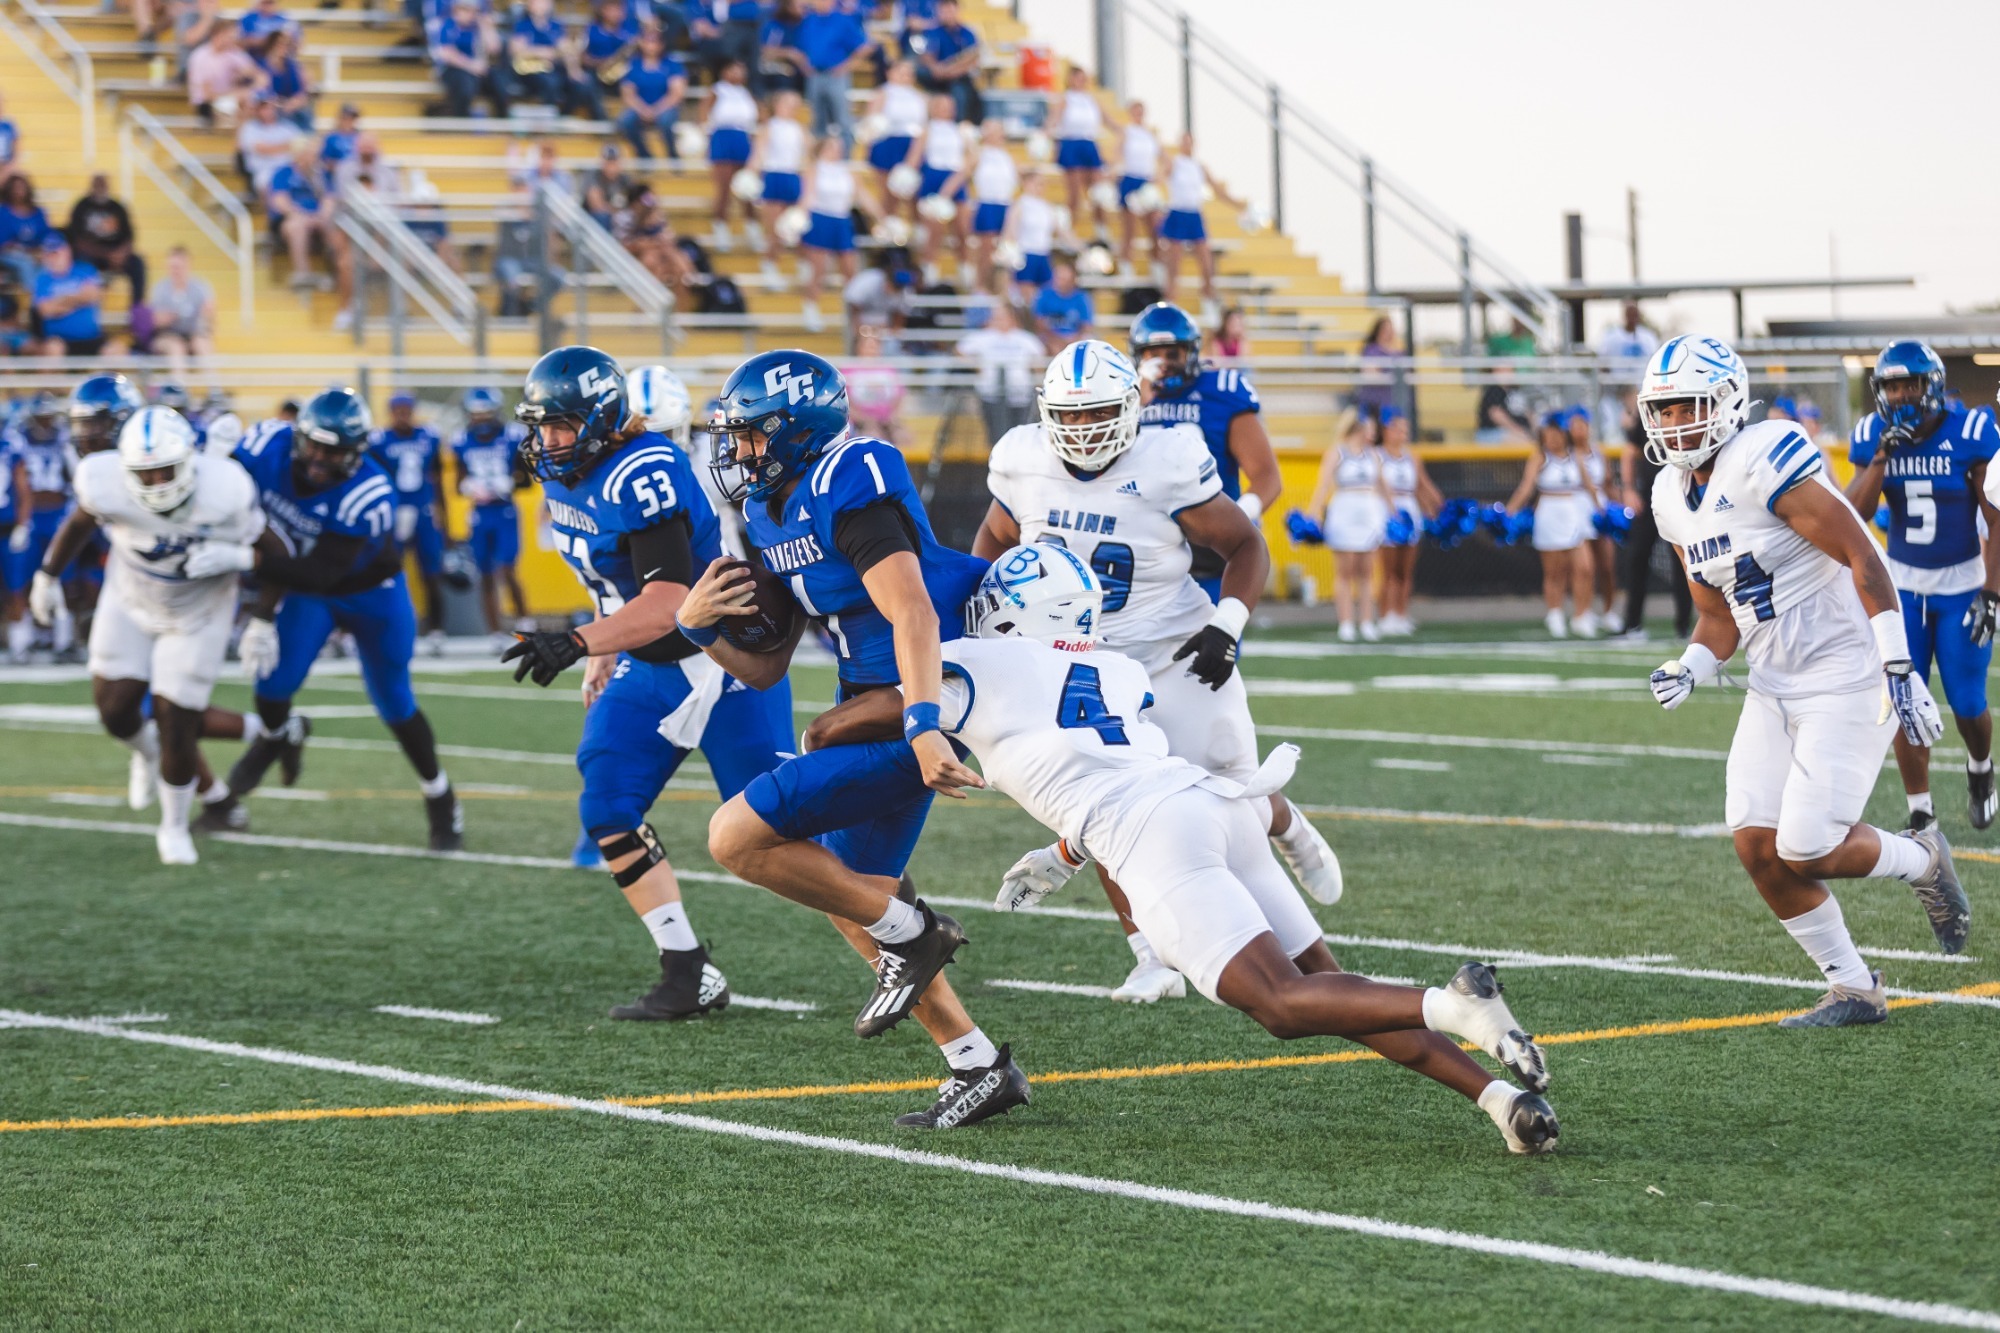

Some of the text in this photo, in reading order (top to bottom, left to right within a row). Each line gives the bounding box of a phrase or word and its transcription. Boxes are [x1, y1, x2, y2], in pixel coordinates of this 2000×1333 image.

[764, 363, 815, 405] CC
[632, 470, 677, 519] 53
[863, 452, 887, 495] 1
[1047, 509, 1117, 535] BLINN
[1714, 503, 1735, 513] adidas
[1904, 480, 1937, 545] 5
[1075, 607, 1093, 636] 4
[1055, 661, 1131, 746] 4
[698, 976, 728, 1006] adidas
